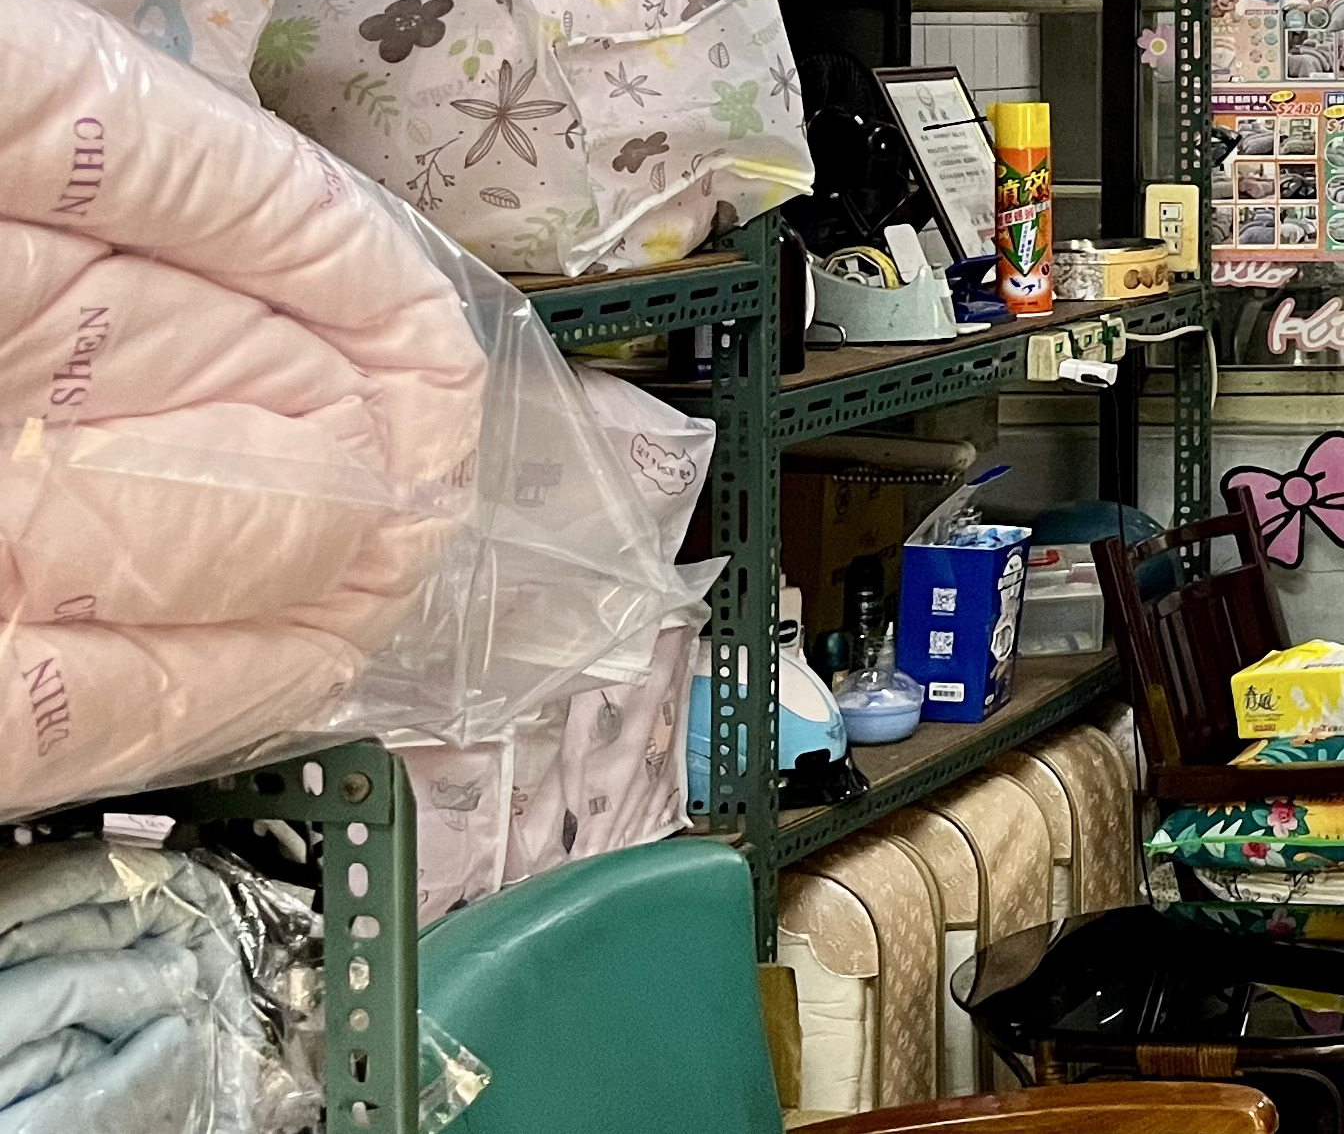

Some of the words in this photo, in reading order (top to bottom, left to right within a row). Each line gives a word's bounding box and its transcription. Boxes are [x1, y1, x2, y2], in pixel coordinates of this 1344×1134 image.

[1277, 103, 1322, 116] $2480
[52, 116, 106, 218] CHIN
[50, 305, 110, 407] SHEN
